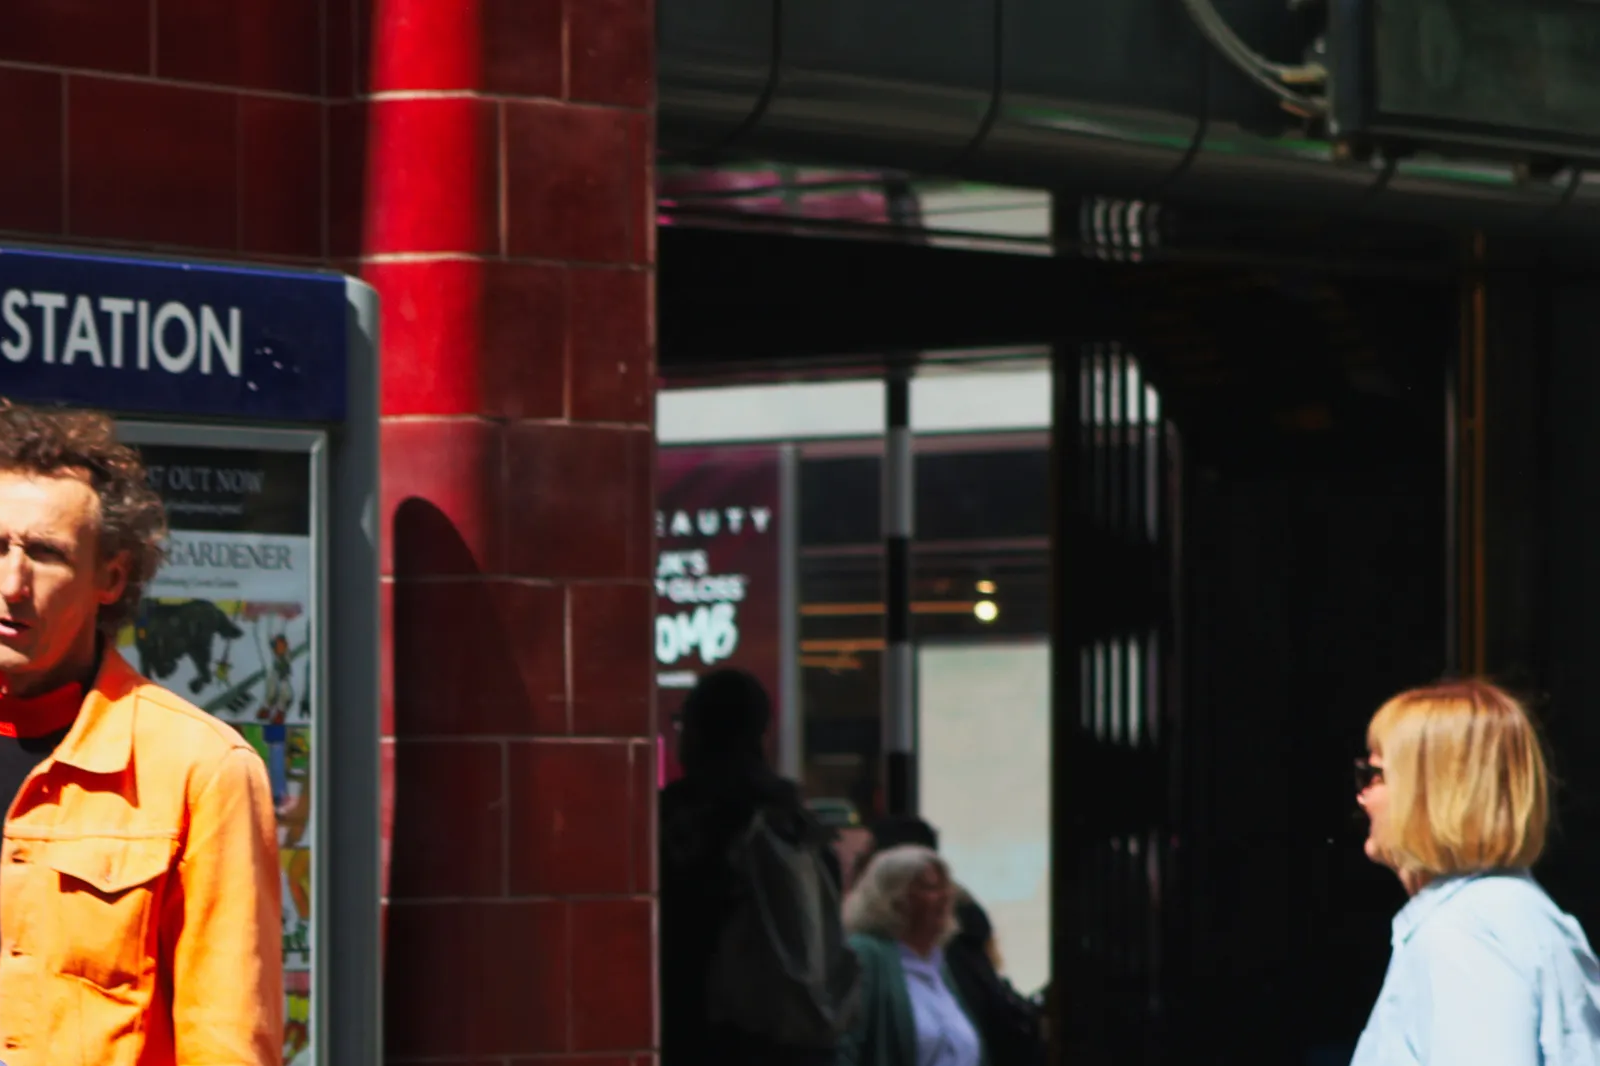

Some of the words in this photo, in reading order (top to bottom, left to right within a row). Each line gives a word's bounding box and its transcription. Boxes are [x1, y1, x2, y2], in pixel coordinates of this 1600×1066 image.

[1, 289, 241, 376] STATION
[168, 465, 212, 492] OUT
[216, 468, 264, 494] NOW
[167, 540, 293, 571] GARDENER
